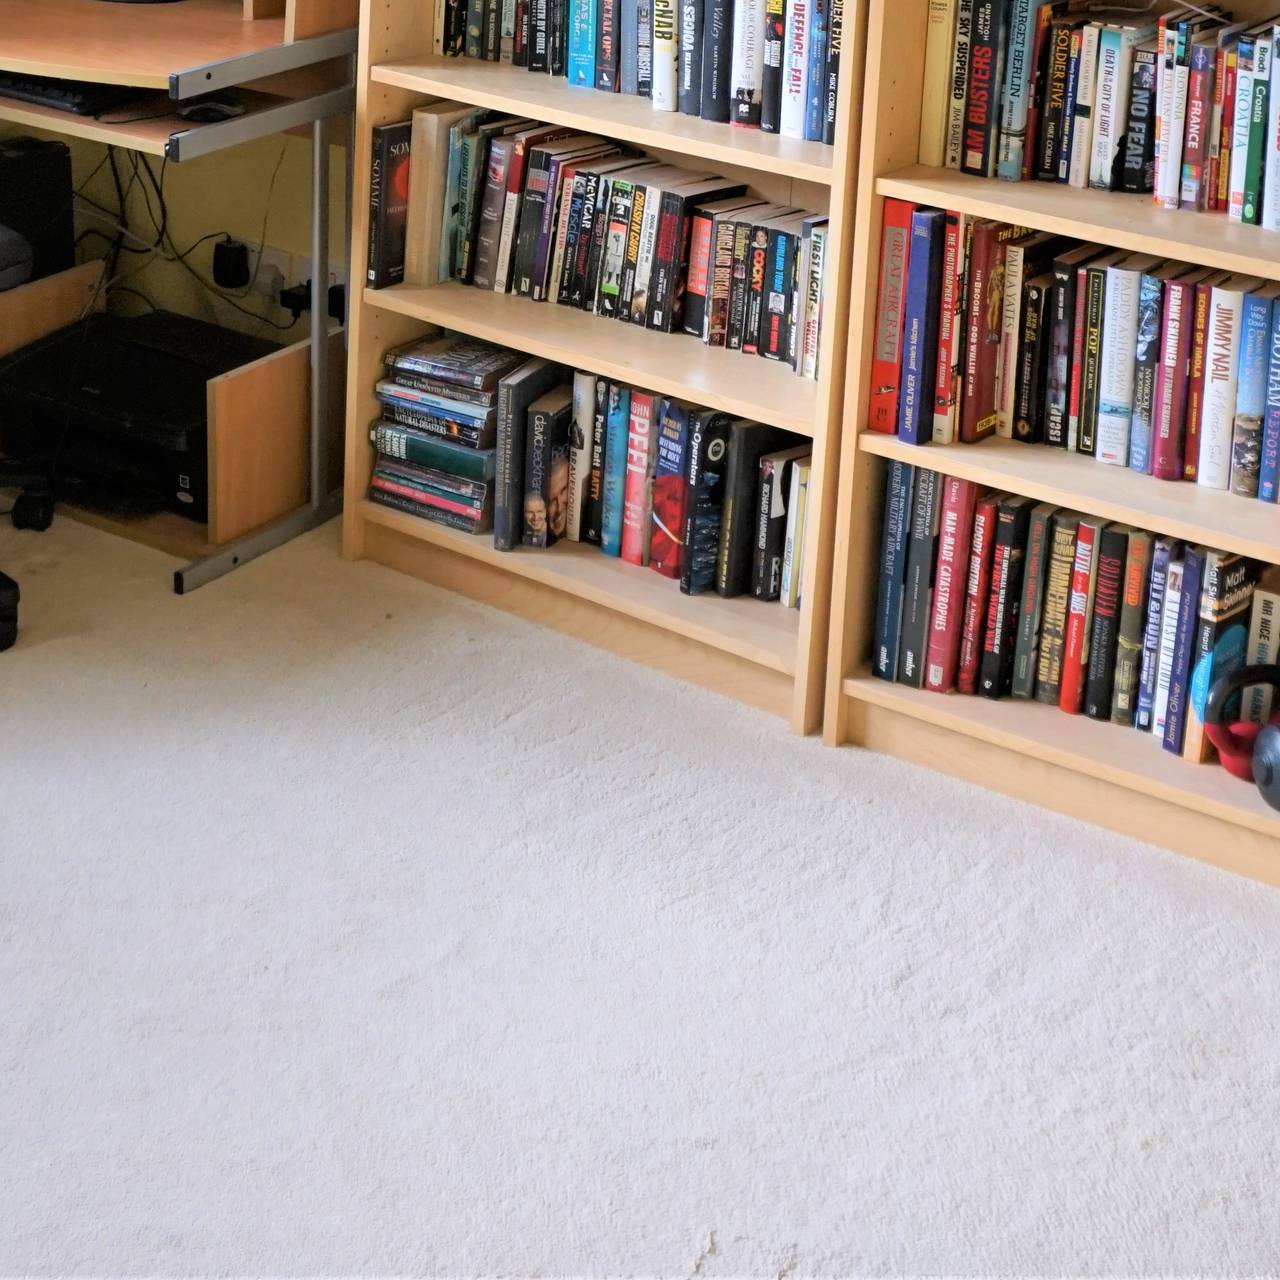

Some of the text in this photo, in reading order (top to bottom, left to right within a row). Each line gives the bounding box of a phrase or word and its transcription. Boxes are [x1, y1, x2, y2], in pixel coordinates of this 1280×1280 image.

[536, 21, 545, 31] BY
[536, 32, 545, 54] GUILE
[711, 7, 723, 39] Valley
[958, 17, 970, 37] SKY
[1010, 0, 1029, 98] TARGET BERLIN
[953, 42, 969, 100] SUSPENDED
[969, 46, 992, 124] BUSTERS
[1044, 29, 1069, 169] SOLDIER FIVE MIKE COBURN
[1253, 46, 1268, 123] Bradt Croatia
[950, 124, 959, 153] BAILEY
[952, 106, 961, 123] JIM
[1125, 88, 1147, 170] NO FEAR
[1188, 100, 1202, 149] FRANCE
[1235, 76, 1252, 148] CROATIA
[567, 197, 583, 244] Muscle
[713, 224, 733, 299] GANGLAND BRITAIN
[751, 248, 765, 292] COCKY
[808, 233, 822, 304] FIRST LIGHT
[941, 232, 956, 341] THE PHOTOGRAPHER'S MANUAL
[1006, 249, 1021, 289] PAULA
[1004, 293, 1017, 329] YATES
[1164, 285, 1183, 367] FRANK SKINNER
[1210, 303, 1234, 383] JIMMY NAIL
[591, 414, 604, 500] Peter Batt BATTY
[627, 414, 649, 475] PEEL
[689, 433, 701, 485] Operators
[1265, 410, 1280, 469] REPORT
[759, 483, 770, 549] RICHARD HAMMOND
[934, 511, 958, 631] MAN-MADE CATASTROPHES
[968, 514, 985, 596] BLOODY BRITAIN
[1259, 600, 1274, 641] MR NICE
[879, 646, 889, 673] amber
[904, 650, 915, 677] amber
